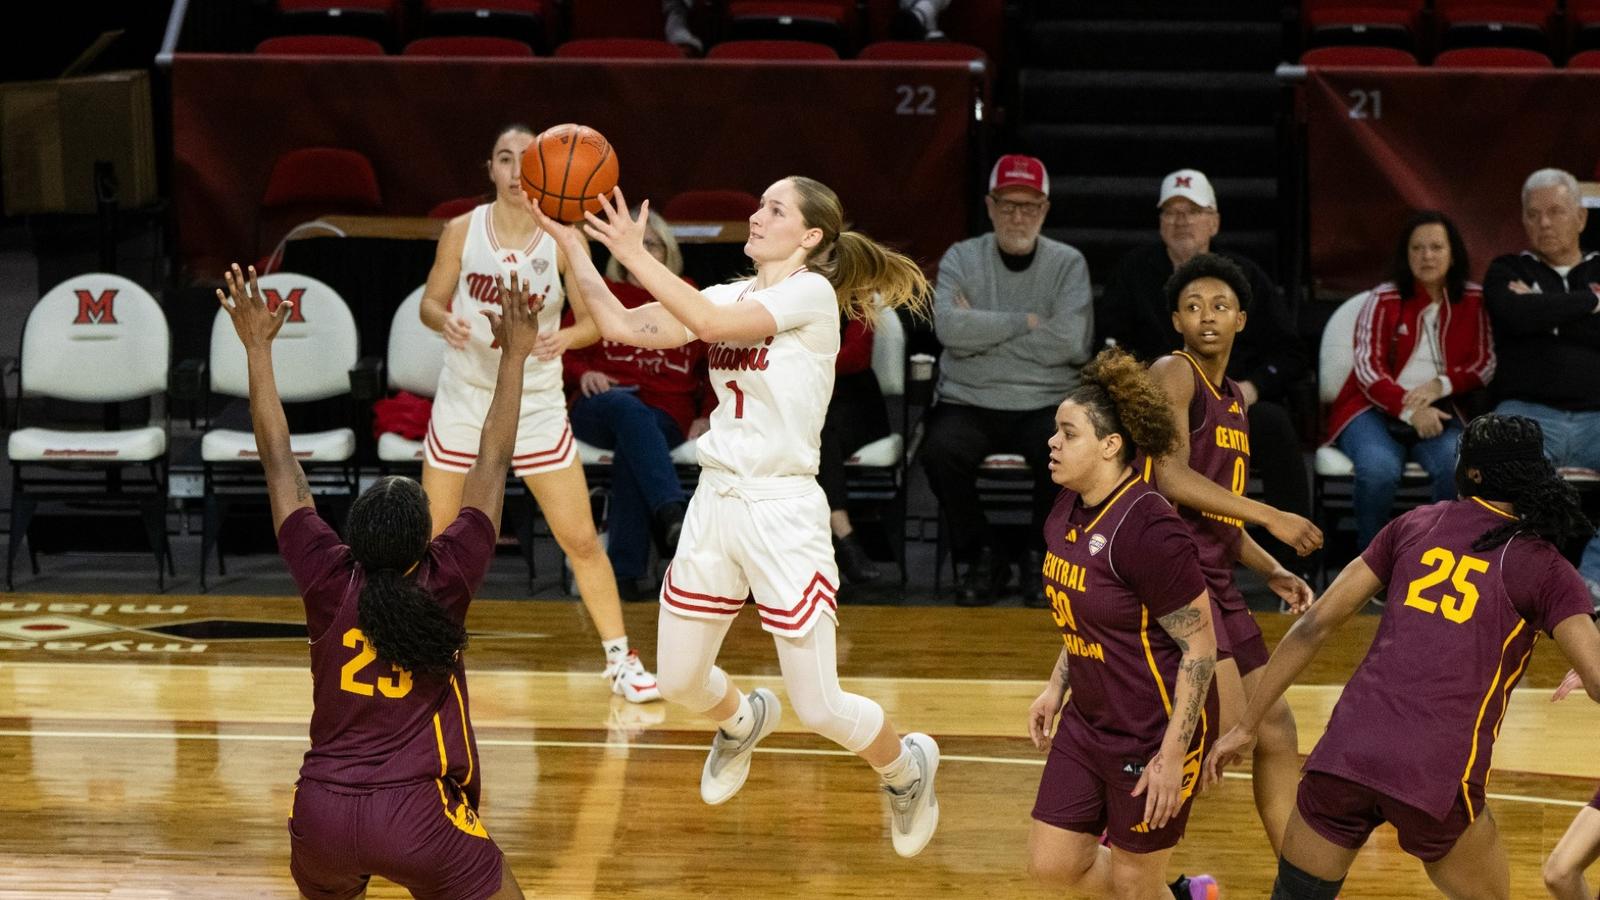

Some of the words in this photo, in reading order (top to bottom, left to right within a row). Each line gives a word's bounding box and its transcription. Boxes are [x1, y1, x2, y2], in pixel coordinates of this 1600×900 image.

[895, 85, 936, 115] 22
[1348, 89, 1381, 119] 21
[1174, 176, 1192, 189] M
[73, 288, 120, 324] M
[261, 288, 307, 323] M
[708, 335, 775, 371] iami
[725, 380, 745, 420] 1
[1231, 456, 1245, 497] 0
[1403, 546, 1490, 625] 25
[1045, 584, 1078, 632] 30
[340, 627, 414, 699] 23
